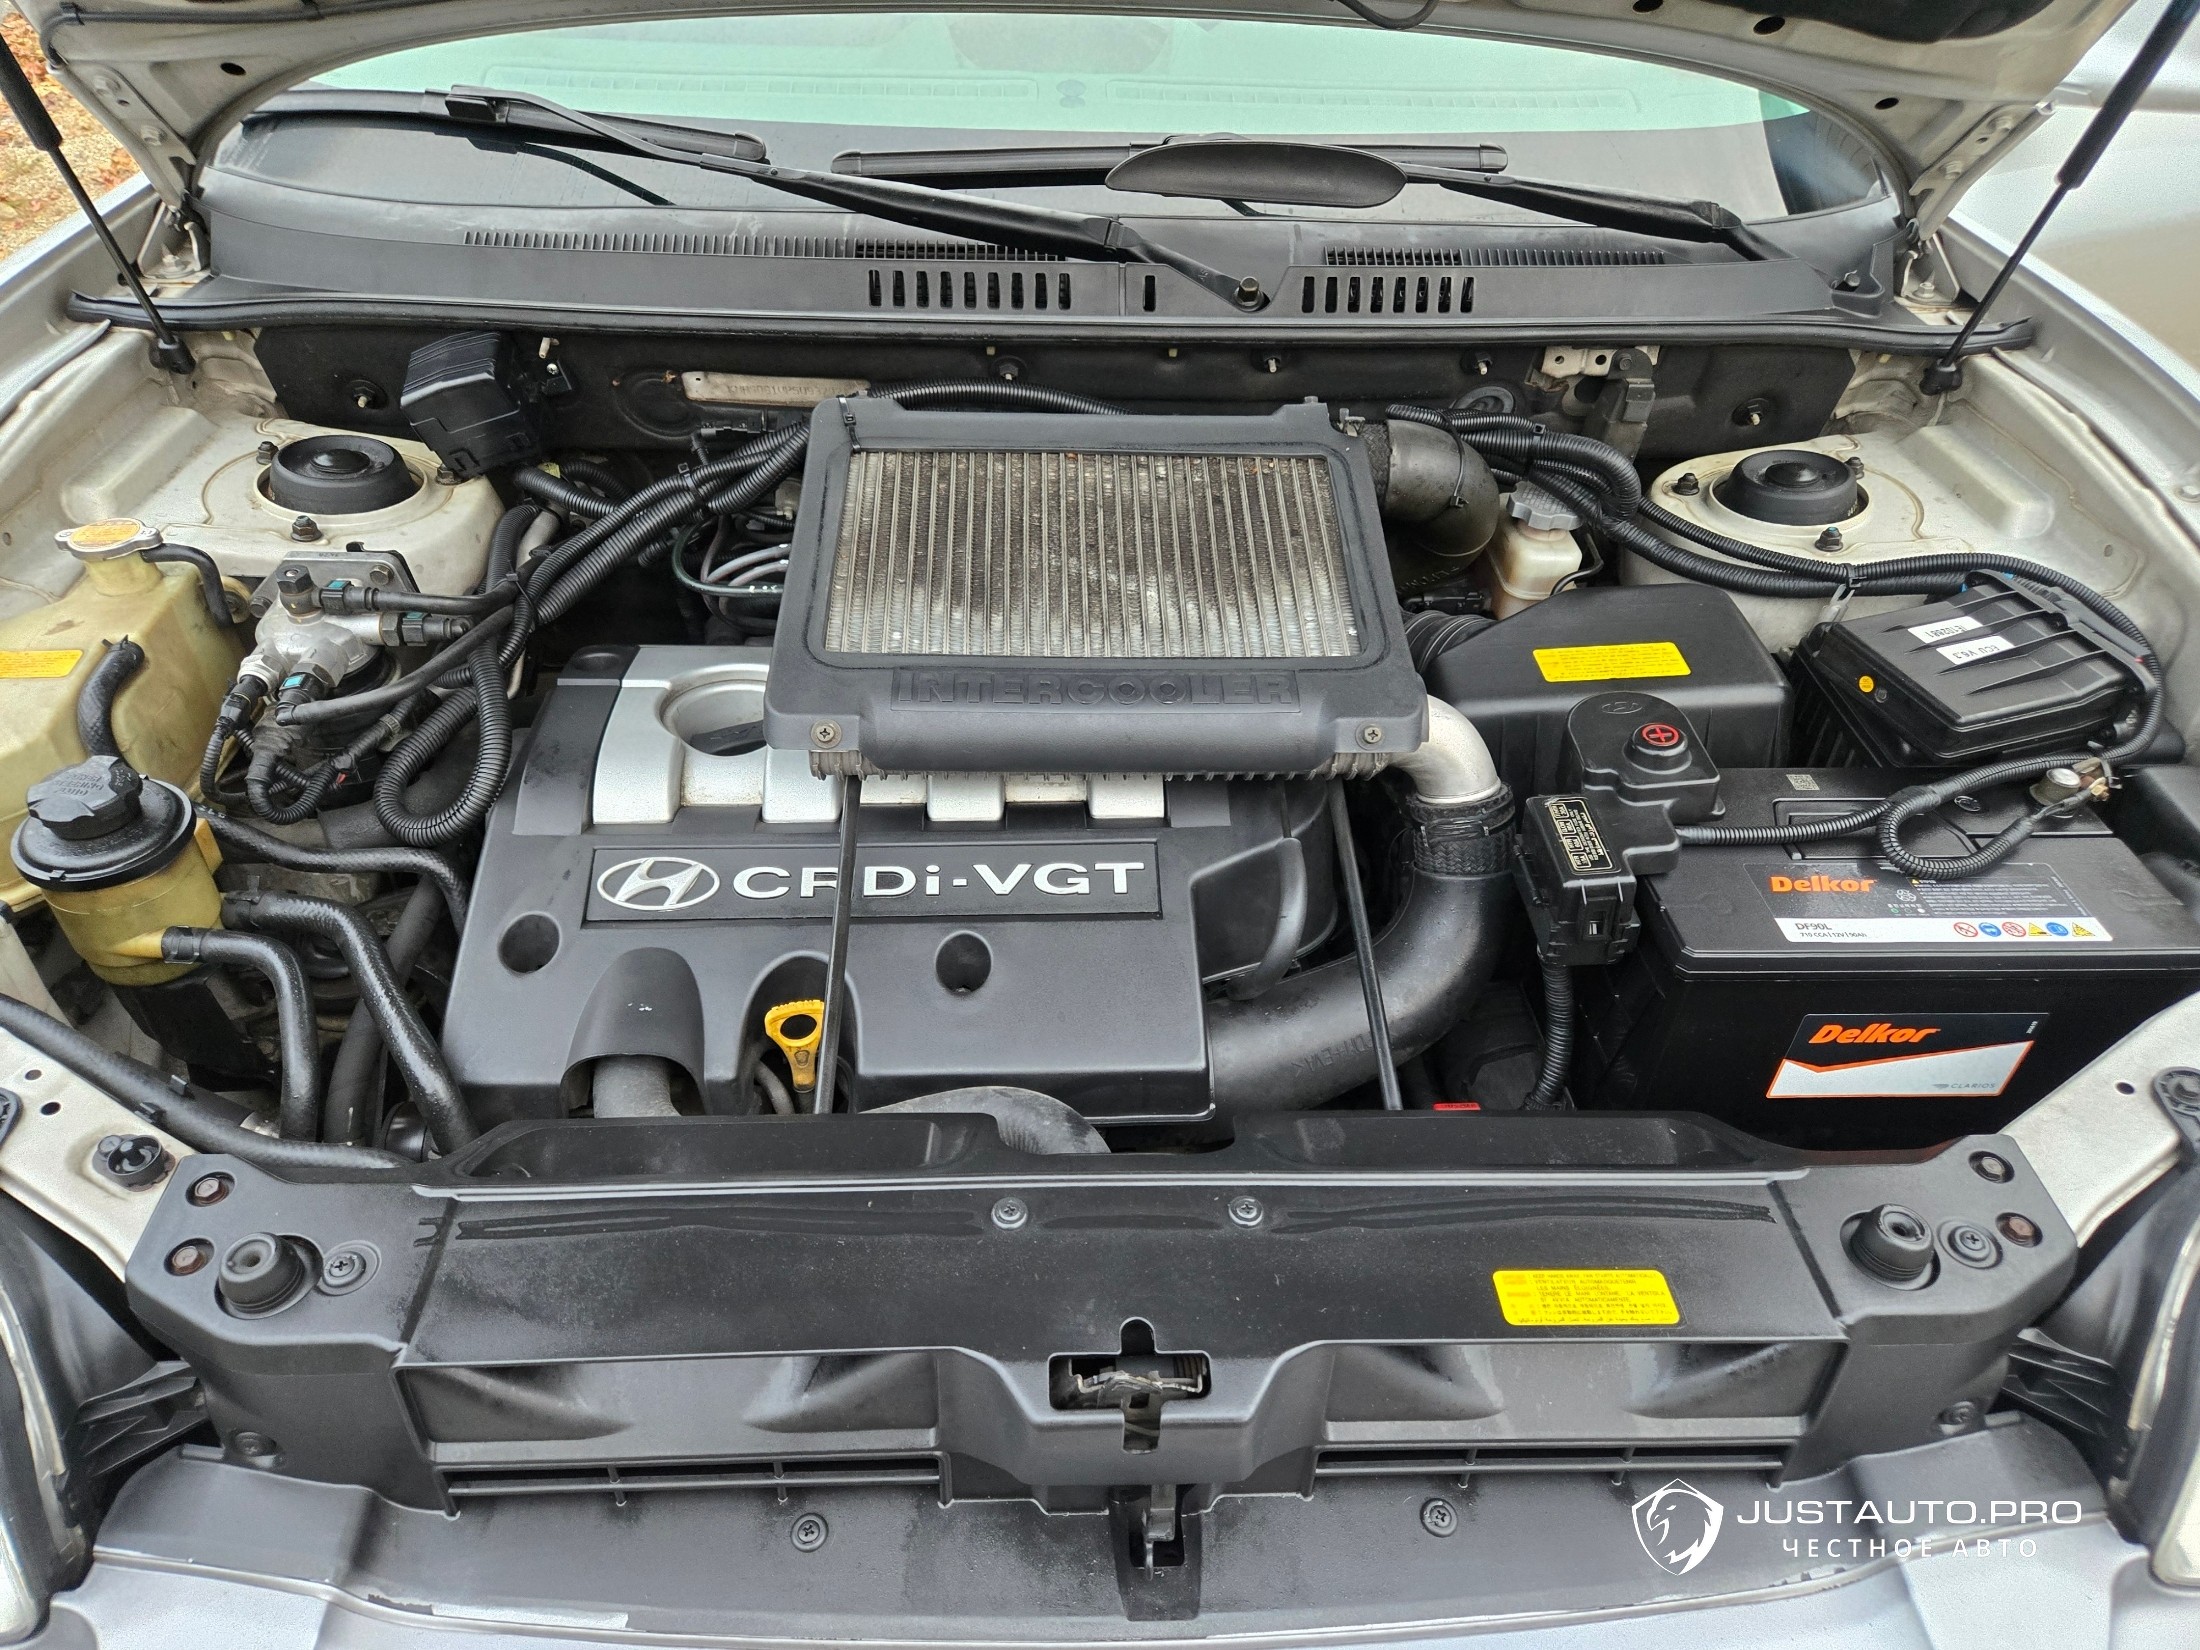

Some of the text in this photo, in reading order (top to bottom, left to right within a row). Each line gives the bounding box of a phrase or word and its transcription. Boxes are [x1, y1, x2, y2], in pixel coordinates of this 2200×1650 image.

[1978, 645, 2000, 655] ECU
[894, 671, 1294, 705] INTERCOOLER
[732, 862, 1145, 898] CRDi-VGT
[1769, 875, 1875, 893] Delkor
[1794, 922, 1832, 931] DF90L
[1808, 1023, 1940, 1044] Delkor
